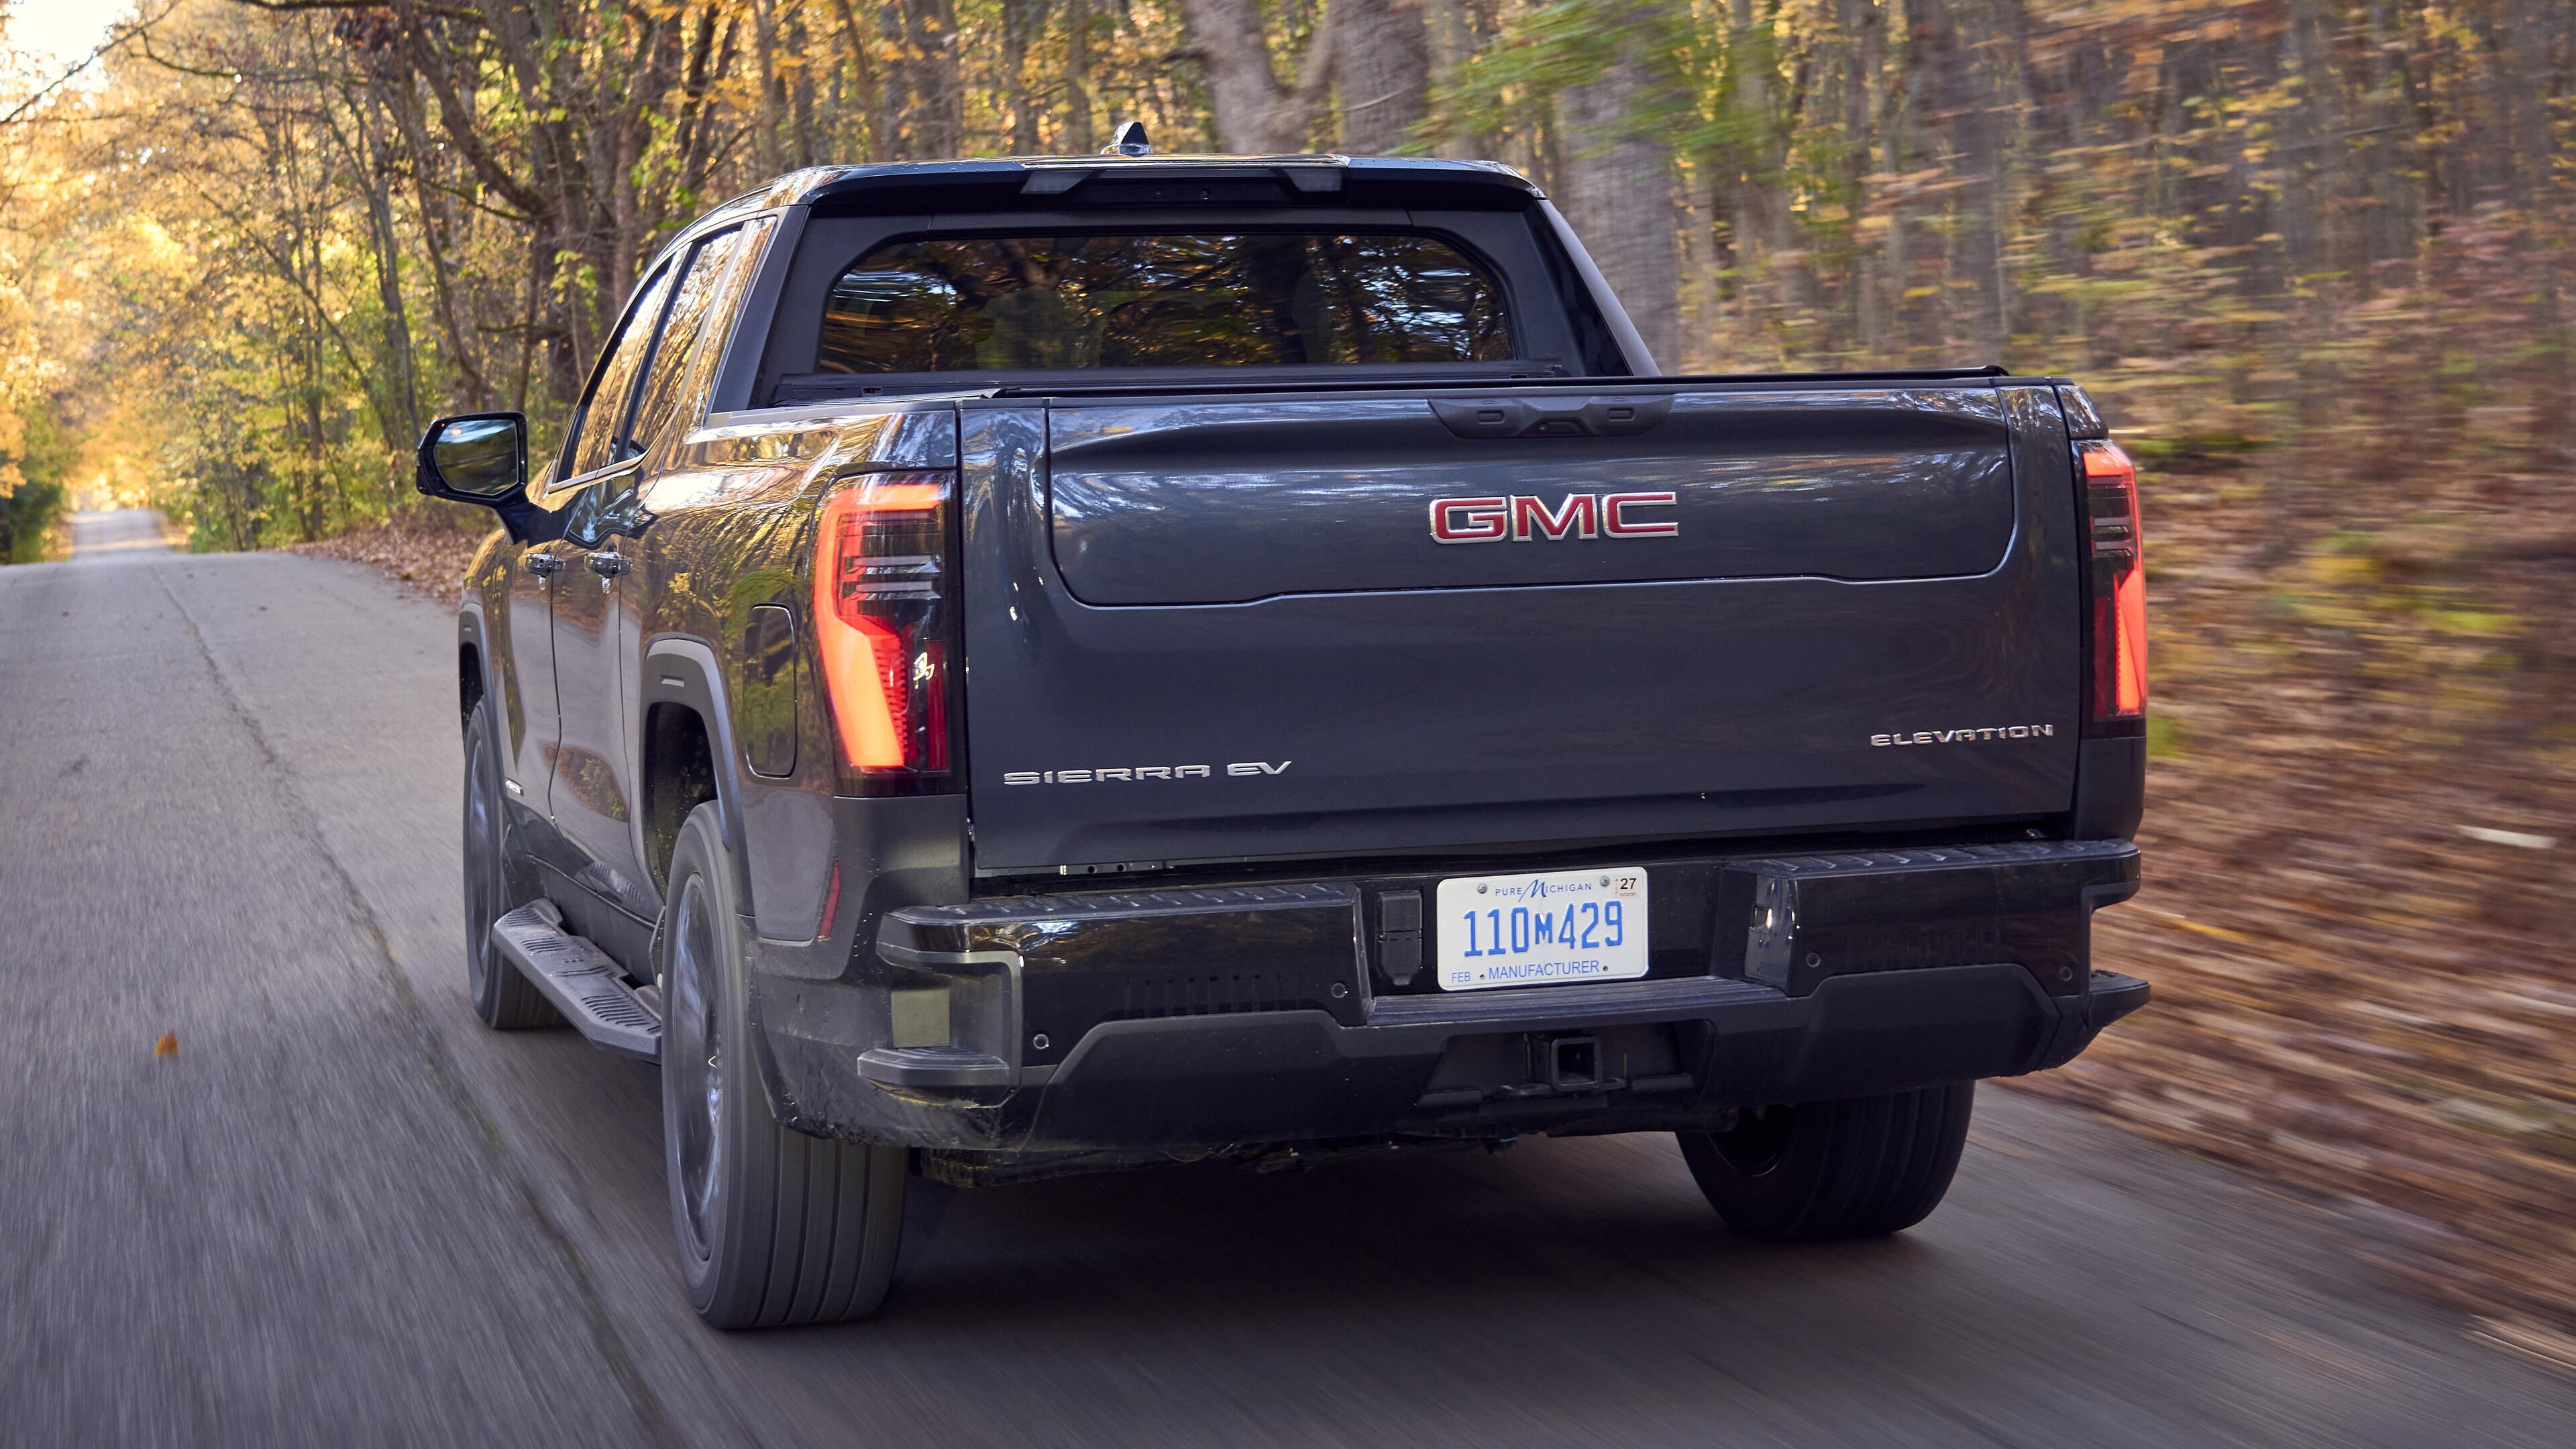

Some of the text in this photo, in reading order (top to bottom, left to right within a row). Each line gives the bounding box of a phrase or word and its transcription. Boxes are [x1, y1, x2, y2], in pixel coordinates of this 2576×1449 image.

[1429, 491, 1679, 545] GMC
[1870, 724, 2053, 747] ELEVATION
[1004, 761, 1292, 786] SIERRA EV
[1495, 879, 1592, 902] PURE MICHIGAN
[1620, 877, 1637, 890] 27
[1462, 900, 1623, 957] 110M429
[1451, 960, 1600, 983] FEB MANUFACTURER
